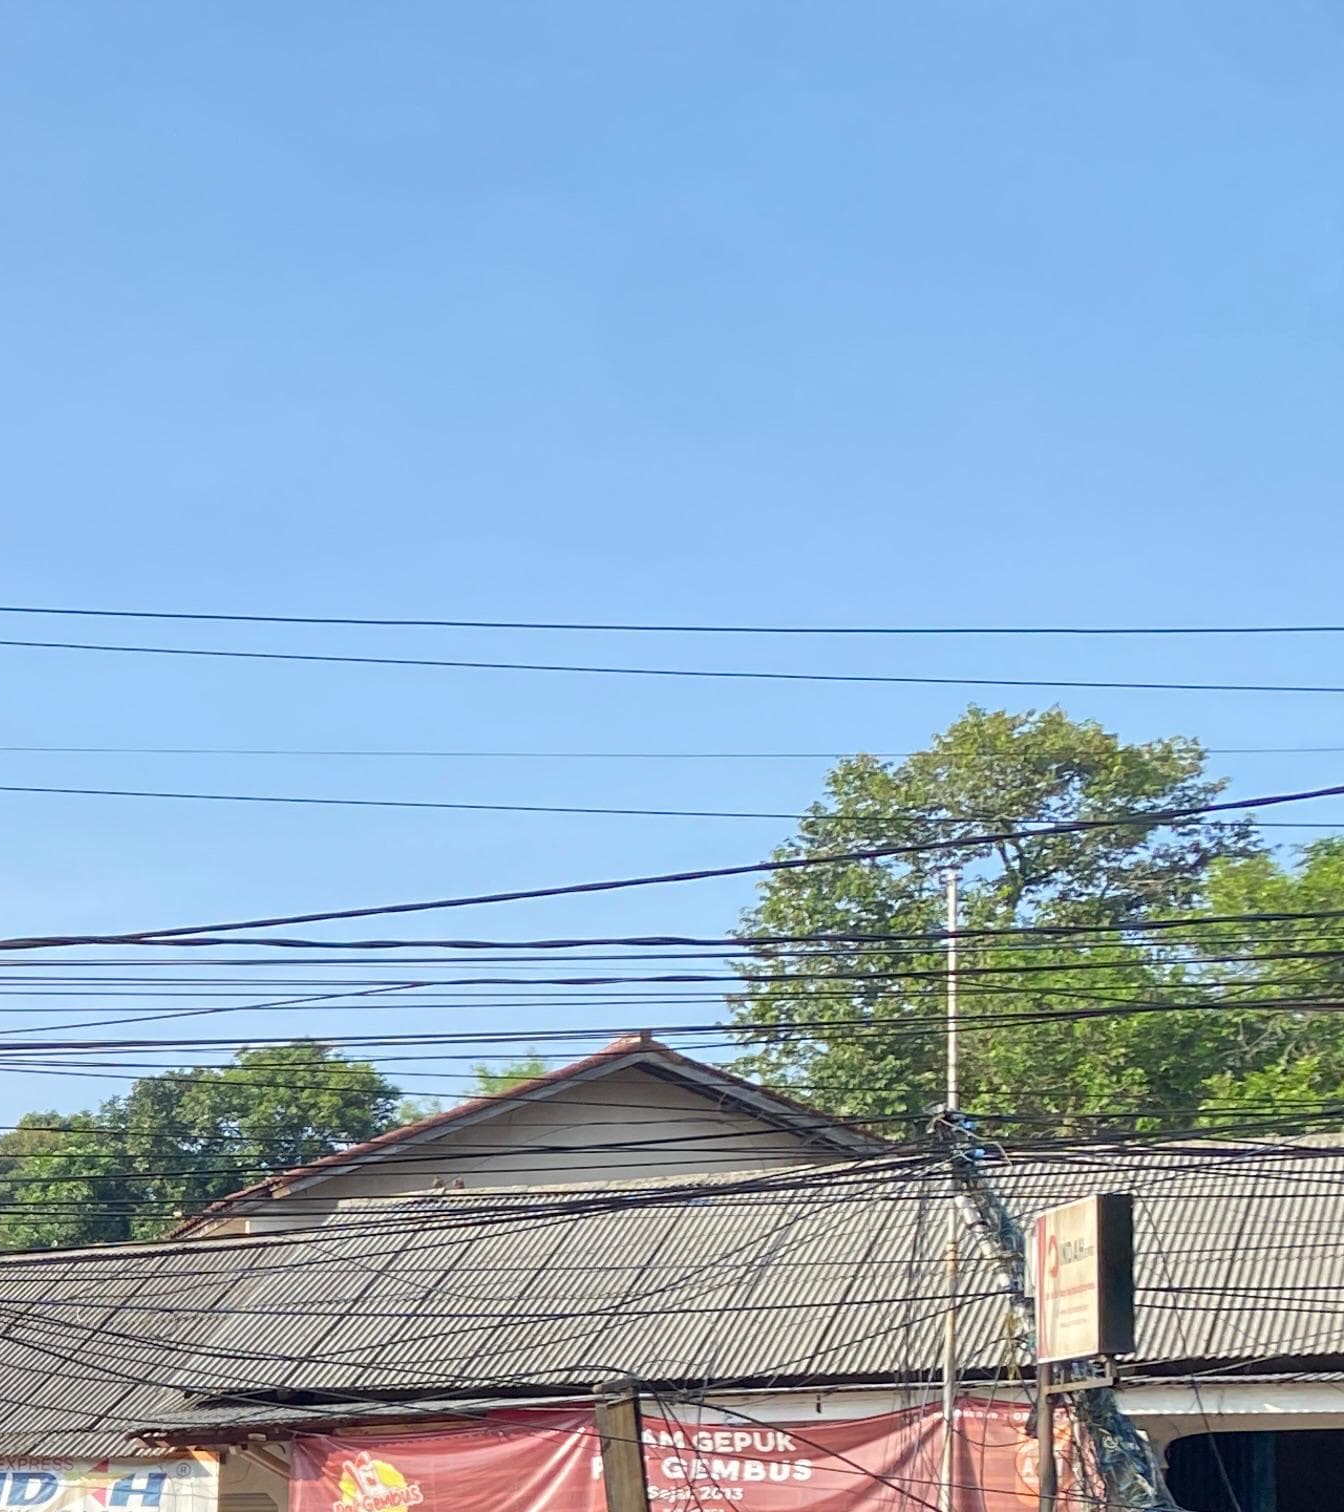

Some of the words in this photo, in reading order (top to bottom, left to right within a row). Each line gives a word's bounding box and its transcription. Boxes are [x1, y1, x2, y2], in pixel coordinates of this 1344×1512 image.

[694, 1431, 797, 1452] GEPUK
[662, 1457, 814, 1481] GEMBUS
[700, 1486, 744, 1501] 2013
